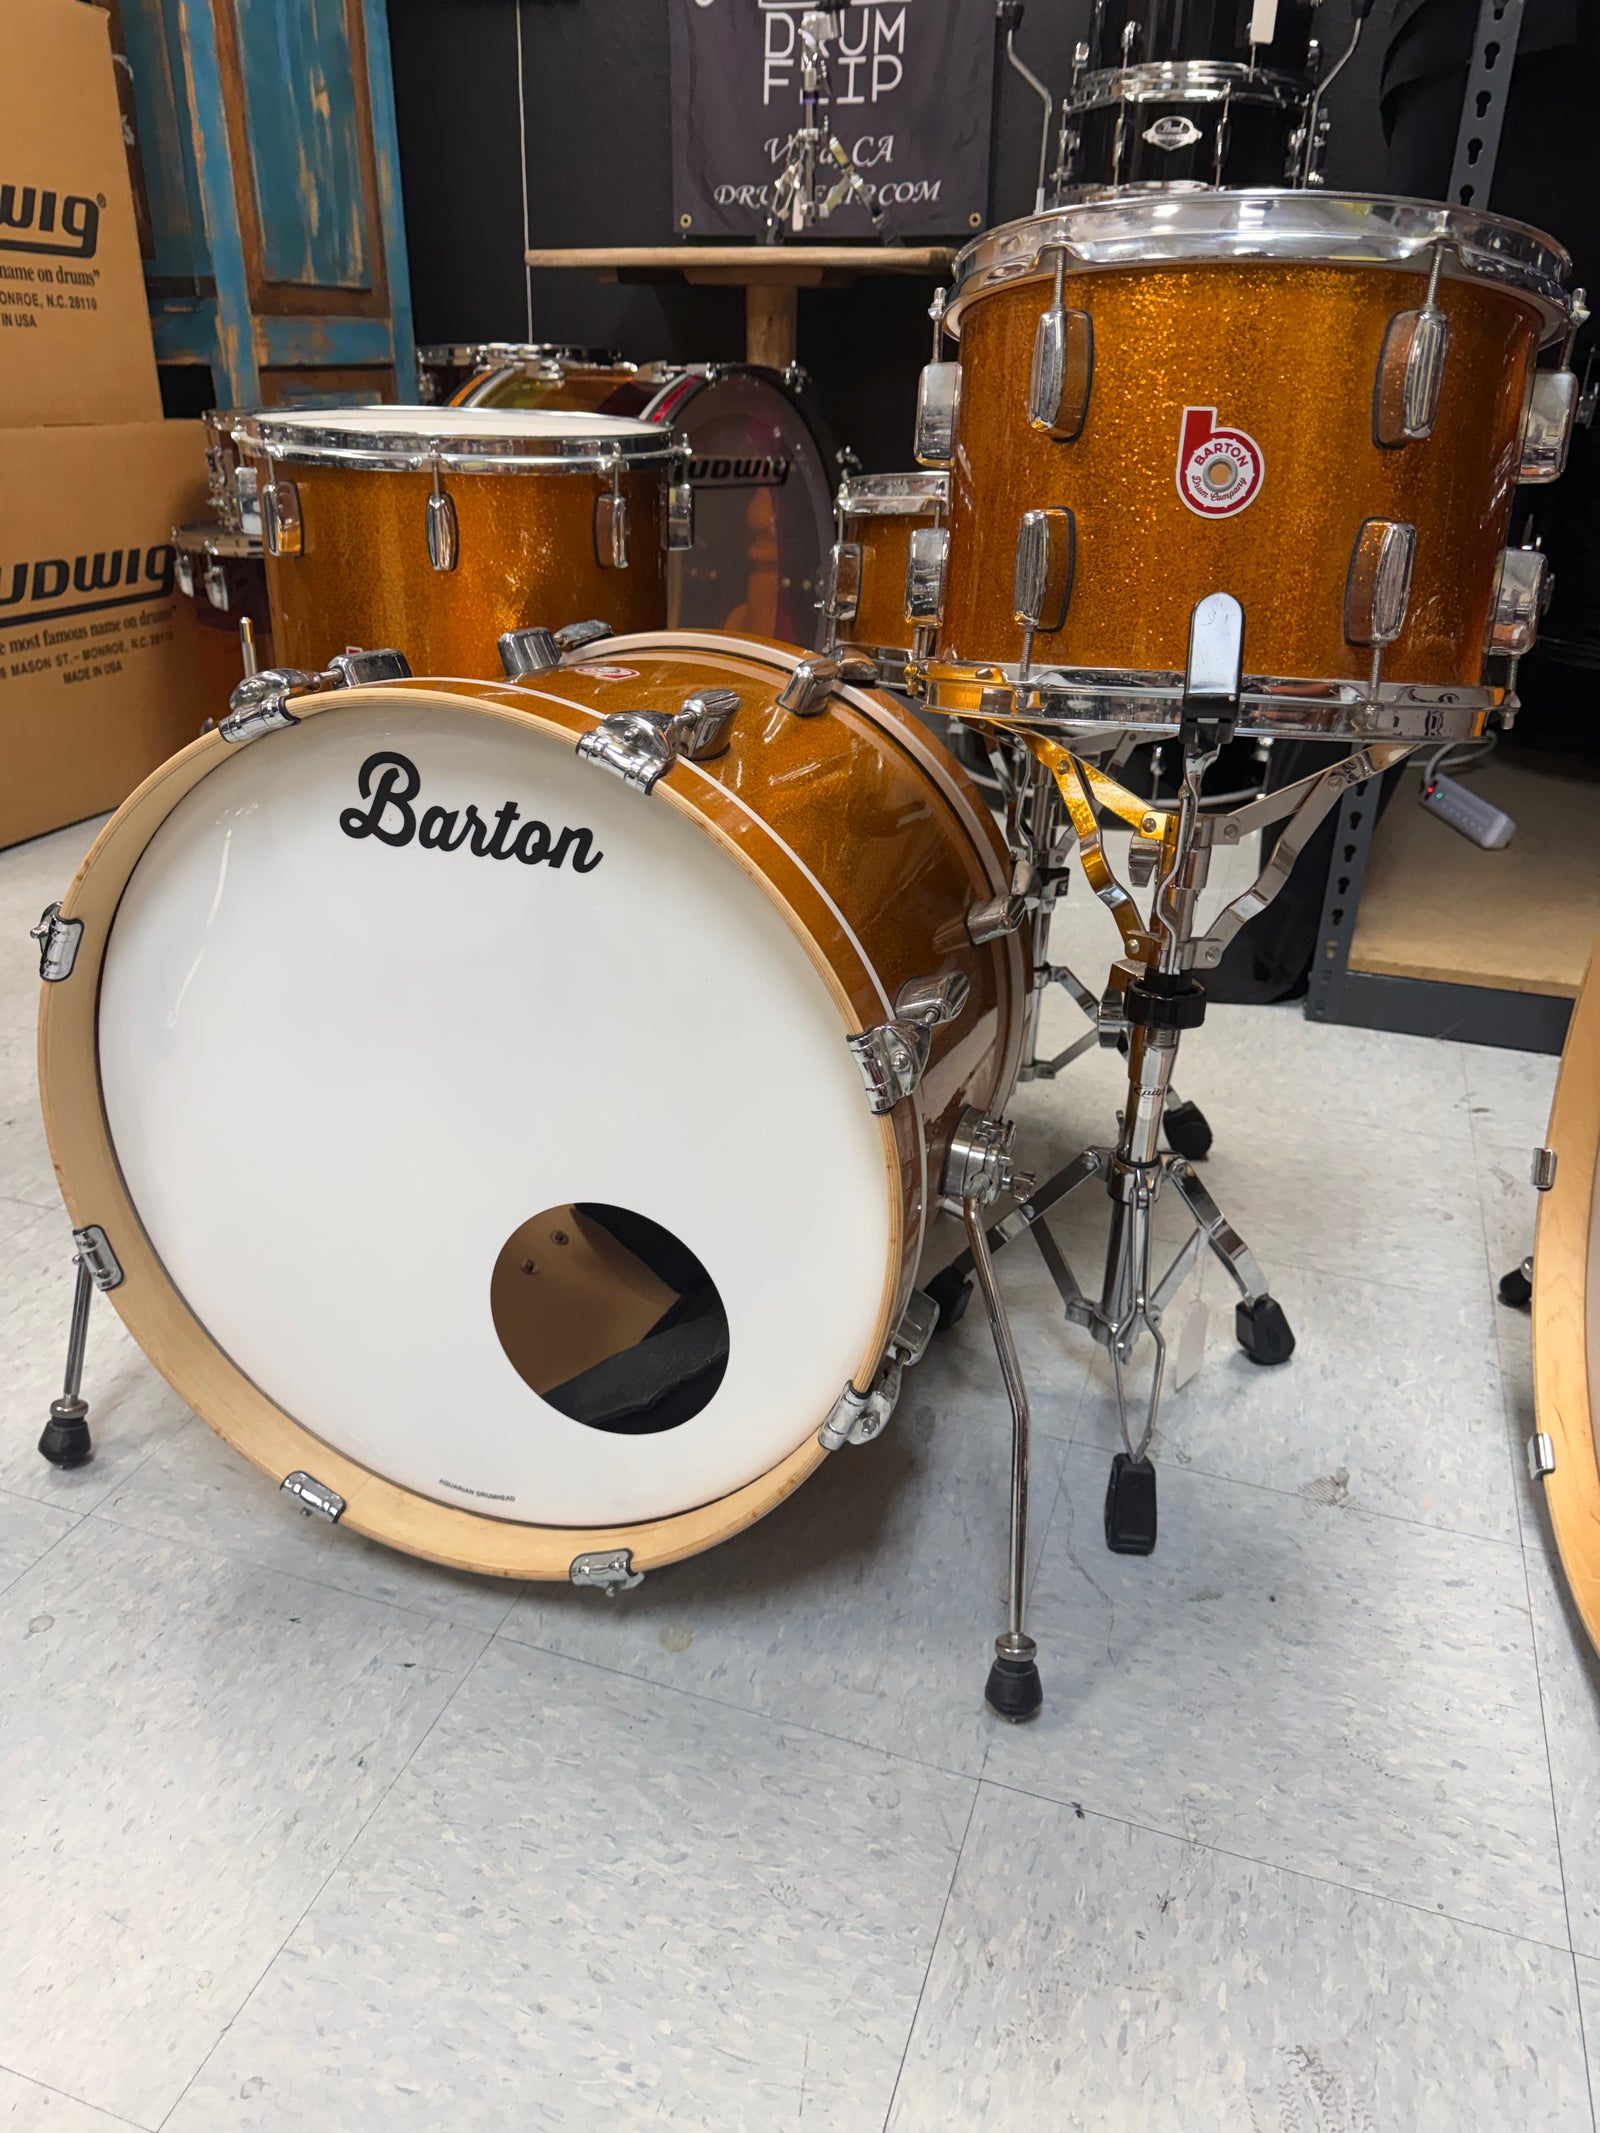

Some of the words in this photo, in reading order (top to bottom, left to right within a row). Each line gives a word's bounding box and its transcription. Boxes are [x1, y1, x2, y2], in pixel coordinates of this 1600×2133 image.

[852, 135, 895, 168] CA
[37, 269, 53, 280] on
[69, 295, 97, 310] 28110
[1, 313, 13, 326] IN
[16, 314, 37, 328] USA
[1194, 442, 1249, 467] BARTON
[1191, 475, 1209, 498] Drum
[1210, 476, 1248, 502] Company
[10, 633, 40, 654] most
[43, 626, 88, 647] famous
[123, 615, 138, 629] on
[11, 657, 52, 677] MASON
[63, 666, 91, 684] MADE
[105, 660, 122, 674] USA
[339, 751, 604, 873] Barton
[438, 1478, 475, 1495] AQUARIAN
